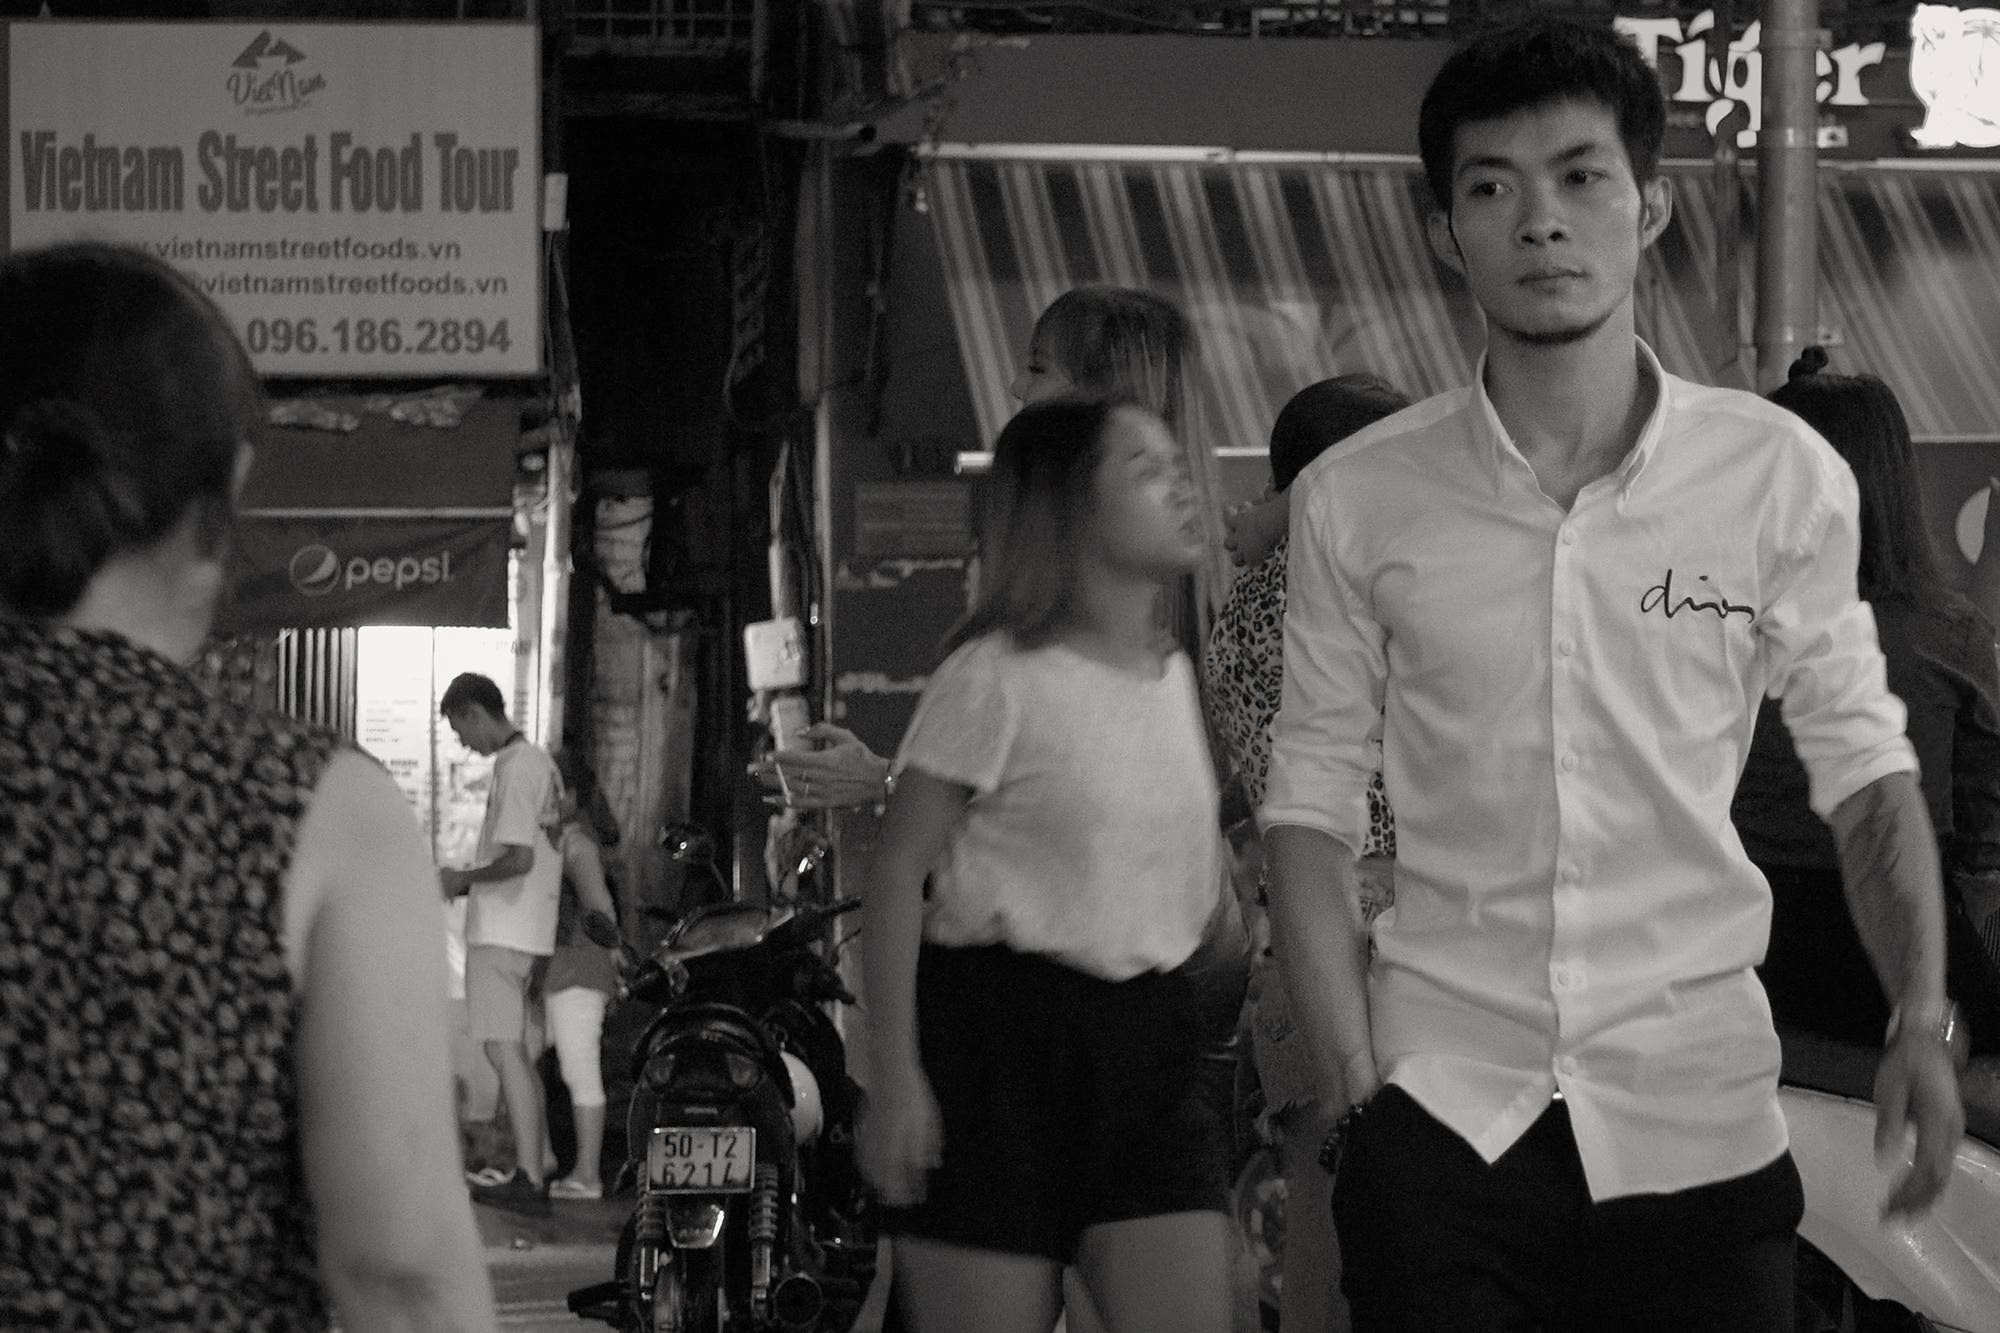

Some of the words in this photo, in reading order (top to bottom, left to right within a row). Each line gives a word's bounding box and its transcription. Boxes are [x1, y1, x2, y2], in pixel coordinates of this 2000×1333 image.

[1613, 9, 1886, 148] Tigr
[20, 130, 184, 213] Vietnam
[199, 129, 319, 213] Street
[330, 131, 423, 212] Food
[434, 132, 520, 212] Tour
[140, 236, 462, 261] vietnamstreetfoods.vn
[247, 317, 512, 356] 096.186.2894
[344, 550, 451, 592] pepsi
